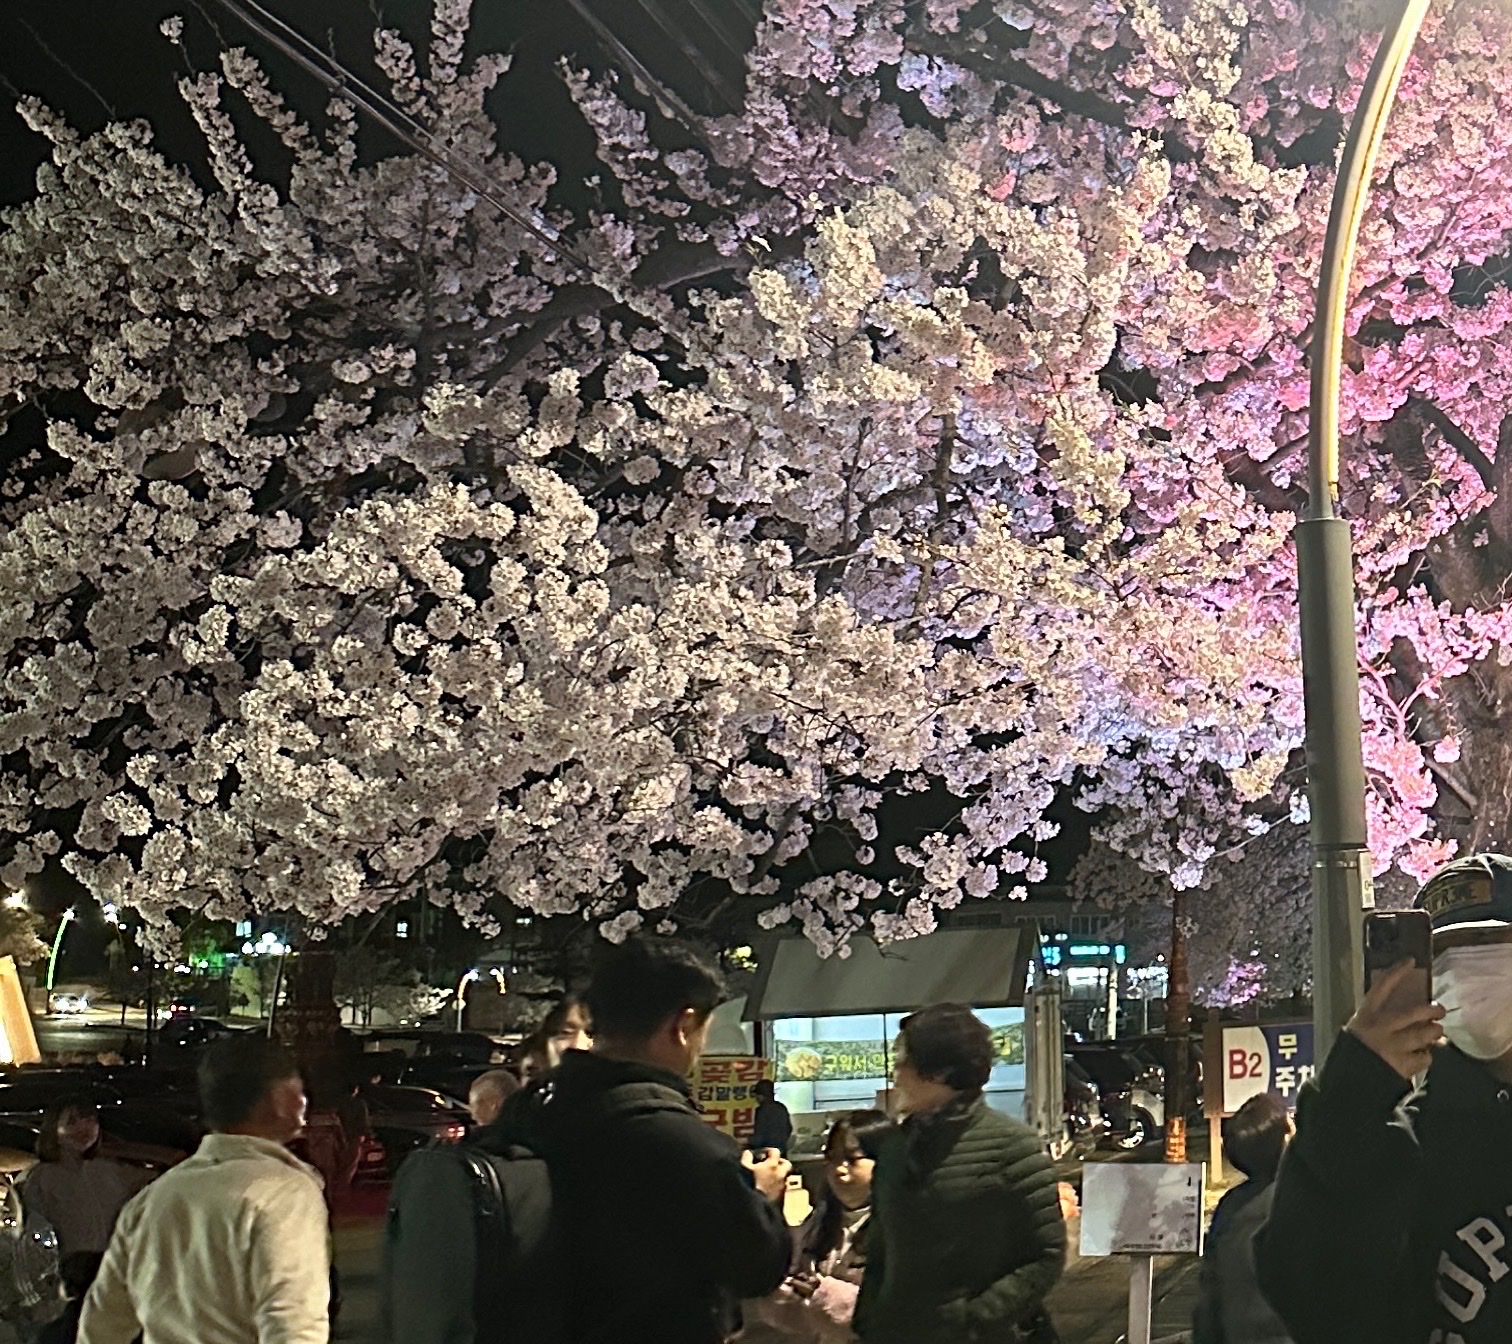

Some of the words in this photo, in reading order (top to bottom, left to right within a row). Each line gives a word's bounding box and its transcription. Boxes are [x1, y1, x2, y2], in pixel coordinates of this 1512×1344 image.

[701, 1059, 769, 1083] 곶감
[824, 1053, 867, 1072] 구워서
[1229, 1048, 1262, 1080] B2
